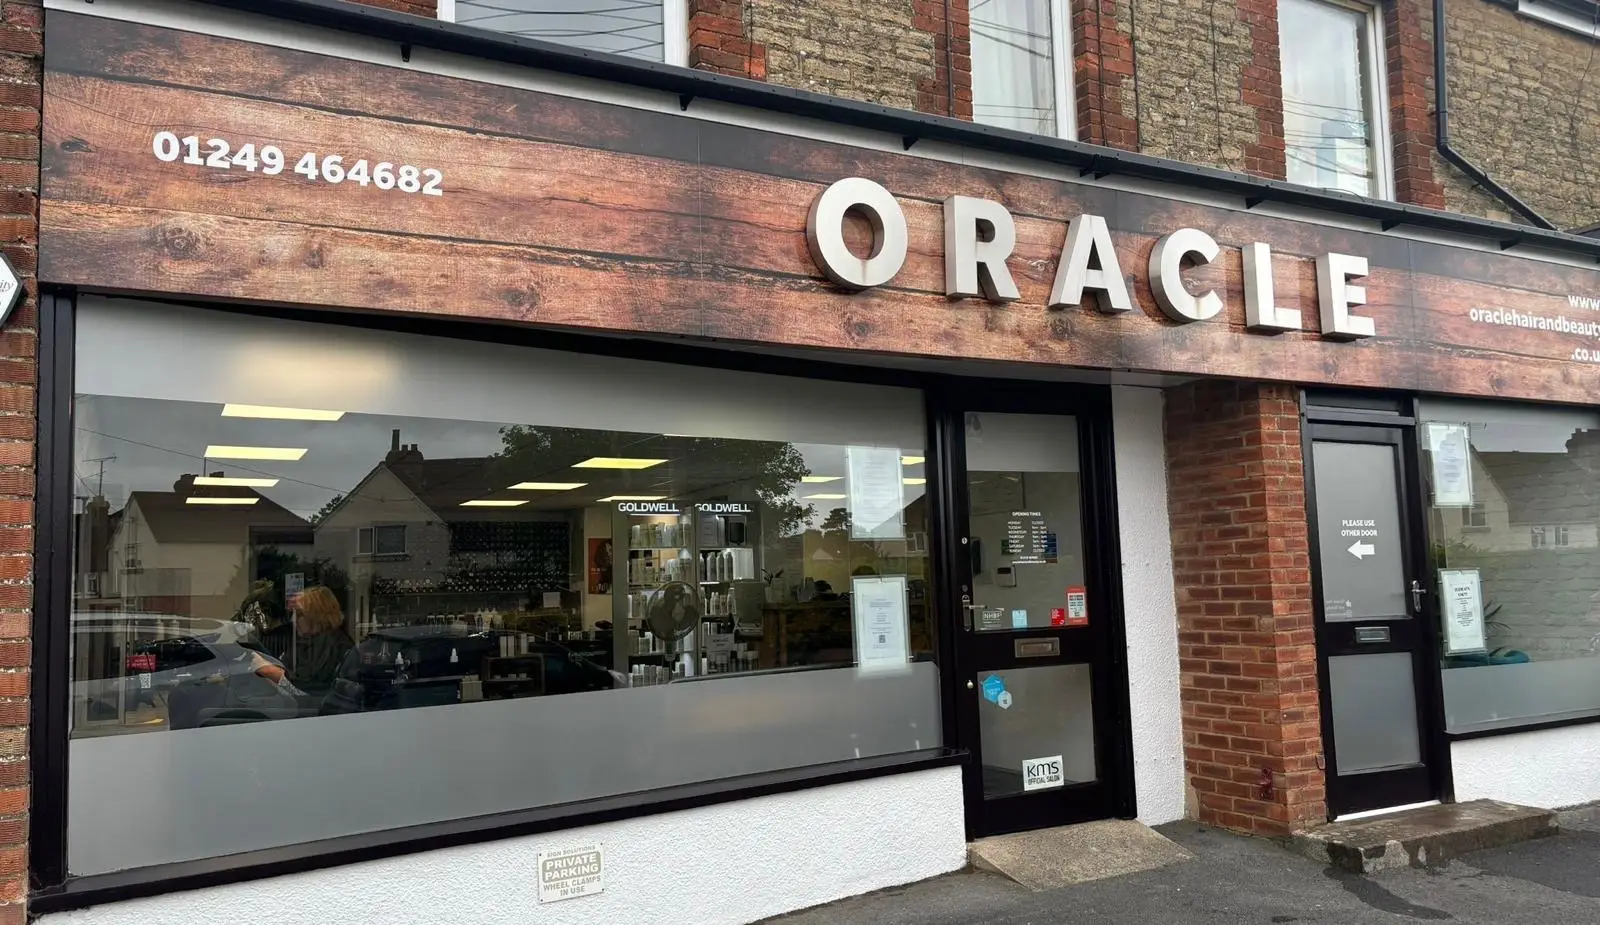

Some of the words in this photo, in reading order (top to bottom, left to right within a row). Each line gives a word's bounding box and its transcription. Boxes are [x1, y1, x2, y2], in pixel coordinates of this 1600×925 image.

[152, 131, 285, 175] 01249
[294, 152, 443, 196] 464682
[806, 176, 1376, 341] ORACLE
[1469, 307, 1600, 340] oraclehairandbeaut
[618, 502, 679, 512] GOLDWELL
[695, 503, 751, 512] GOLDWELL
[546, 853, 597, 870] PRIVATE
[545, 863, 599, 881] PARKING
[544, 881, 570, 891] WHEEL
[571, 875, 601, 886] CLAMPS
[560, 888, 568, 896] IN
[570, 885, 585, 894] USE
